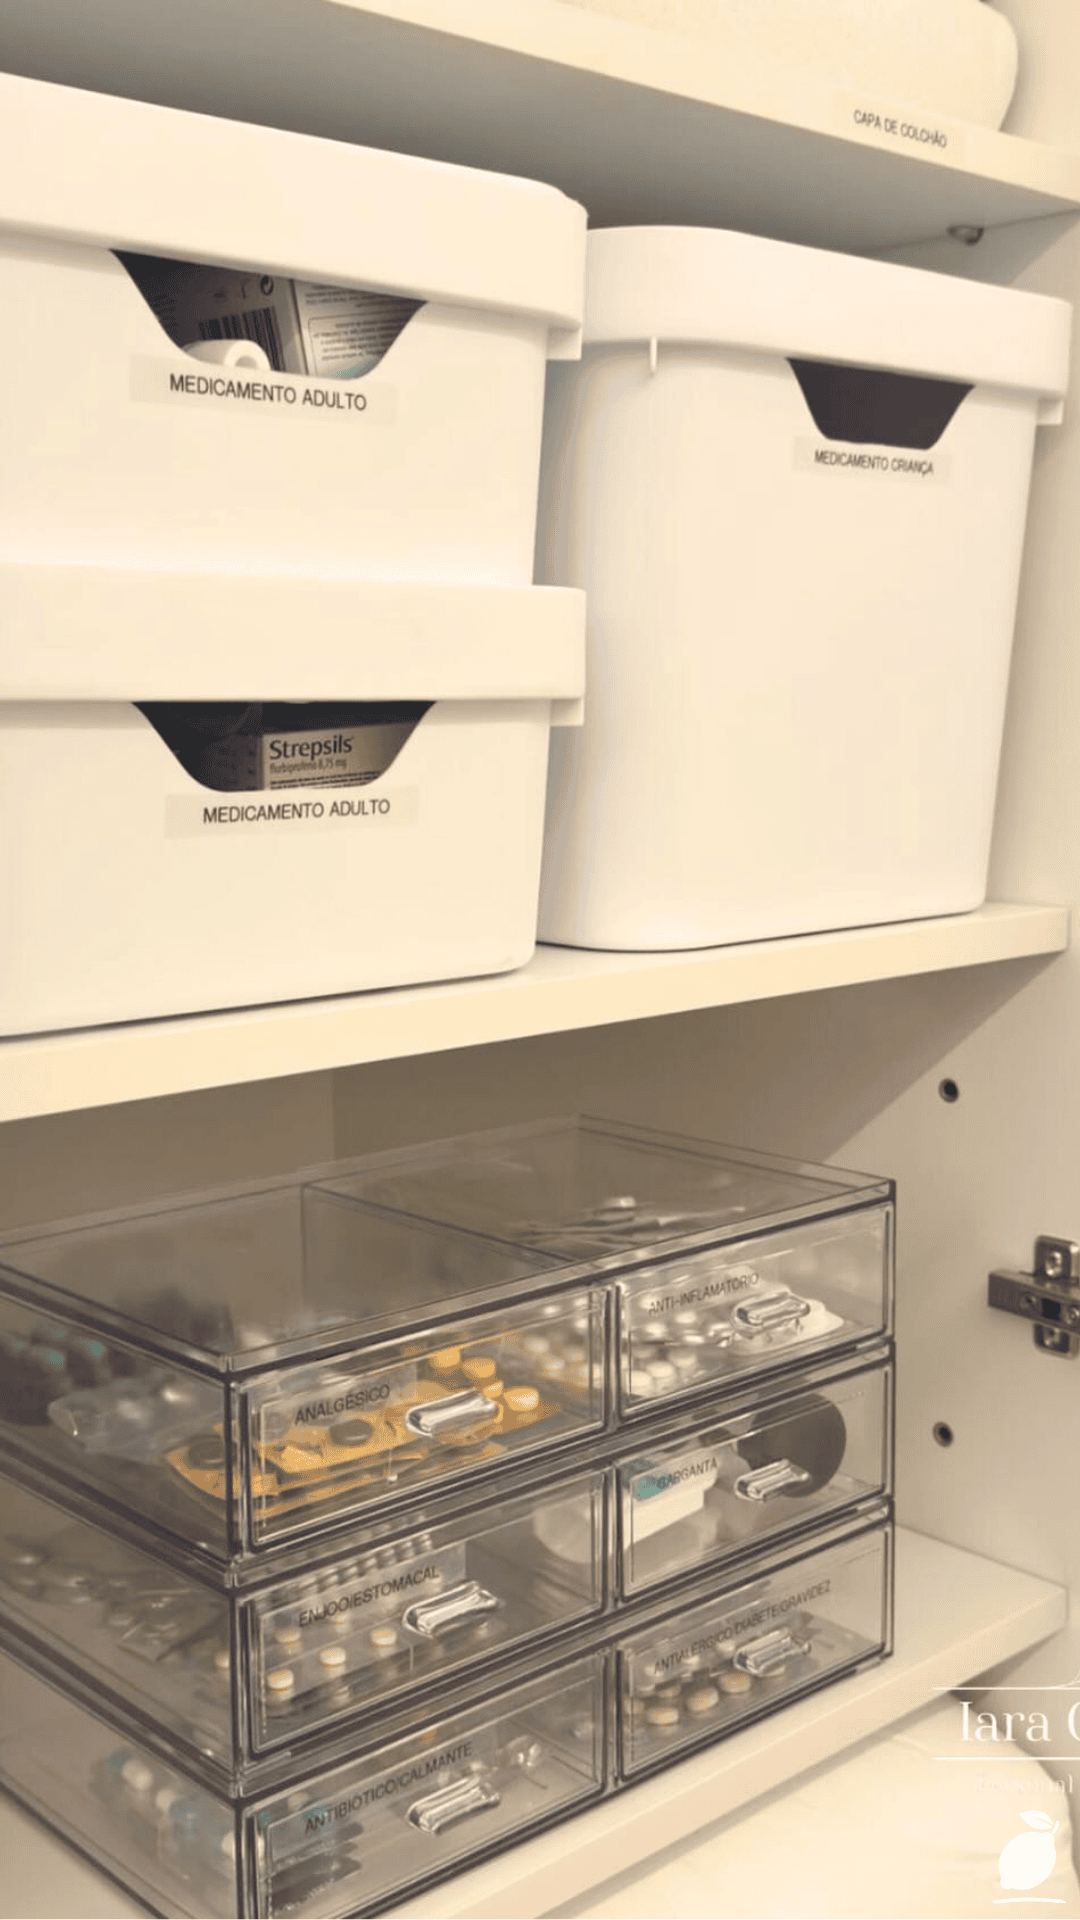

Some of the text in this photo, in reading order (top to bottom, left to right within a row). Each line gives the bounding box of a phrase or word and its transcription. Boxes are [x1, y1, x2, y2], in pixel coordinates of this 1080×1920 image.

[853, 109, 882, 129] CAPA
[884, 118, 898, 135] DE
[169, 373, 367, 411] MEDICAMENTO ADULTO
[814, 449, 934, 477] MEDICAMENTO CRIANÇA
[269, 735, 353, 760] Strepsils
[203, 798, 391, 824] MEDICAMENTO ADULTO
